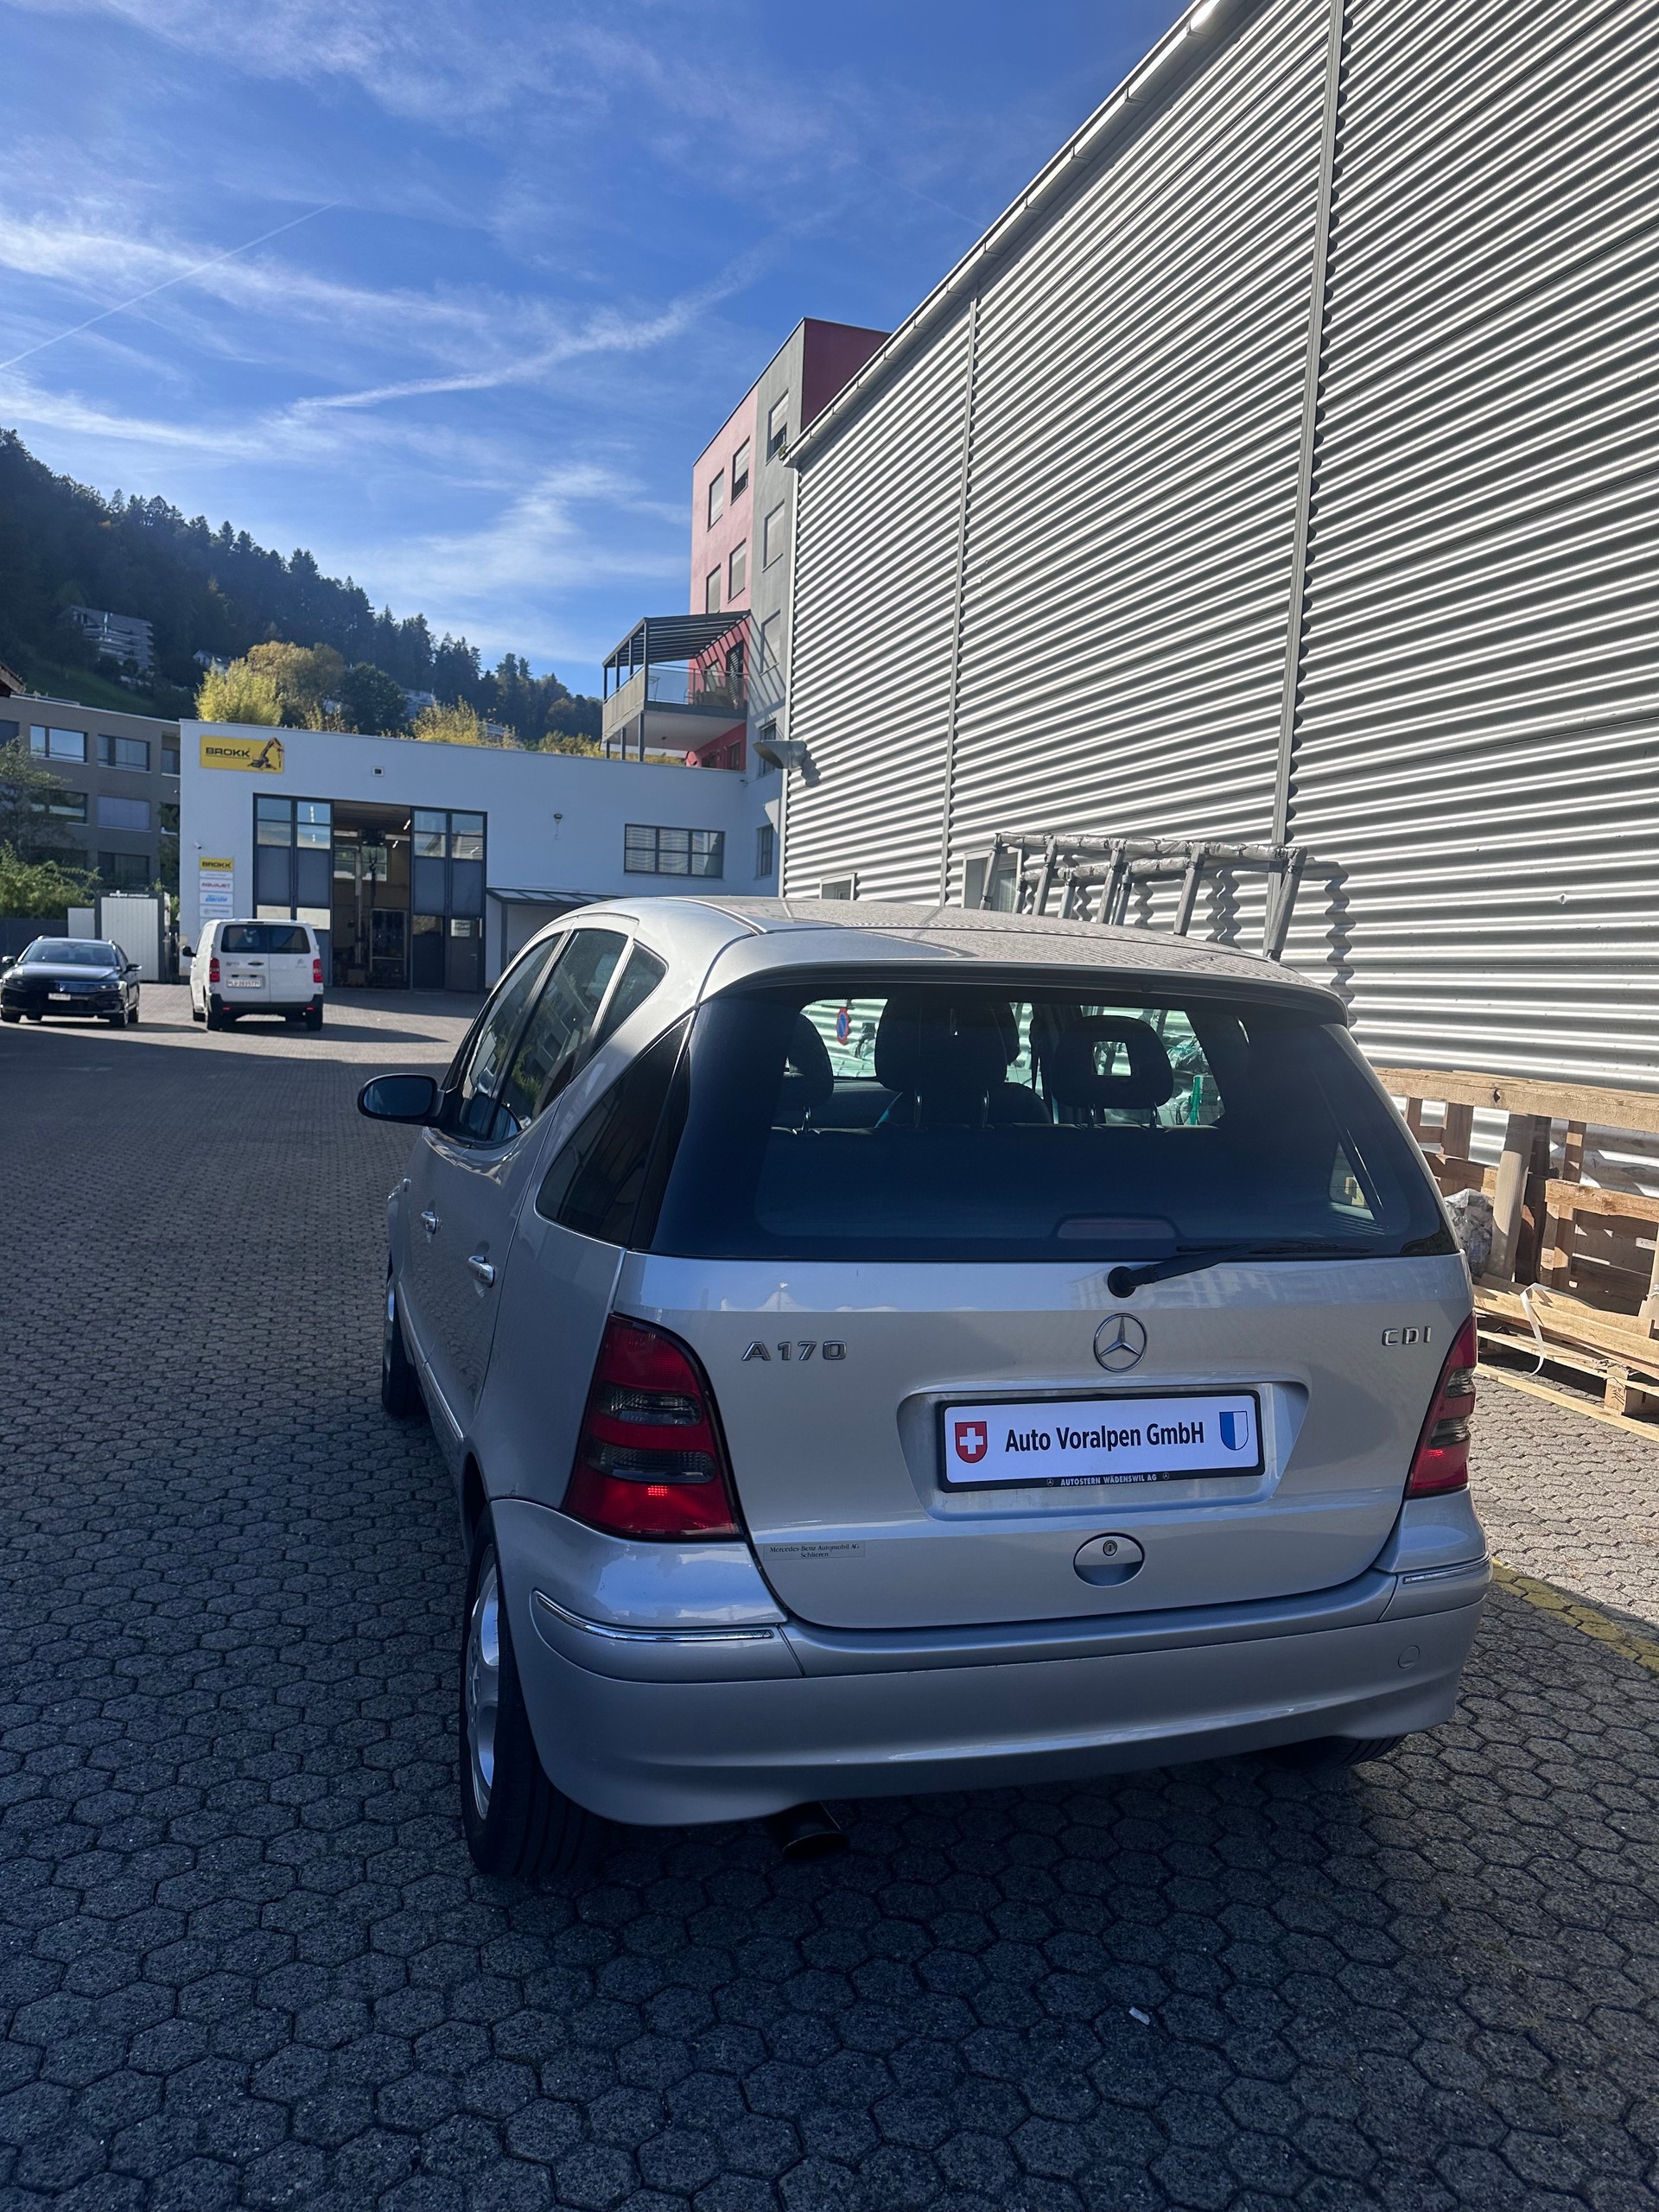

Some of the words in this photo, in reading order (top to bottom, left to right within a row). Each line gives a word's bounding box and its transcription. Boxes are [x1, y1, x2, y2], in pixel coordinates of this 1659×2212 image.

[206, 747, 250, 758] BROKK
[1382, 1325, 1432, 1346] CDI
[1005, 1429, 1052, 1452] Auto
[1056, 1425, 1141, 1452] Voralpen
[1146, 1421, 1205, 1446] GmbH
[1060, 1476, 1101, 1486] AUTOSTERN
[1103, 1474, 1145, 1484] WÄDENSWIL
